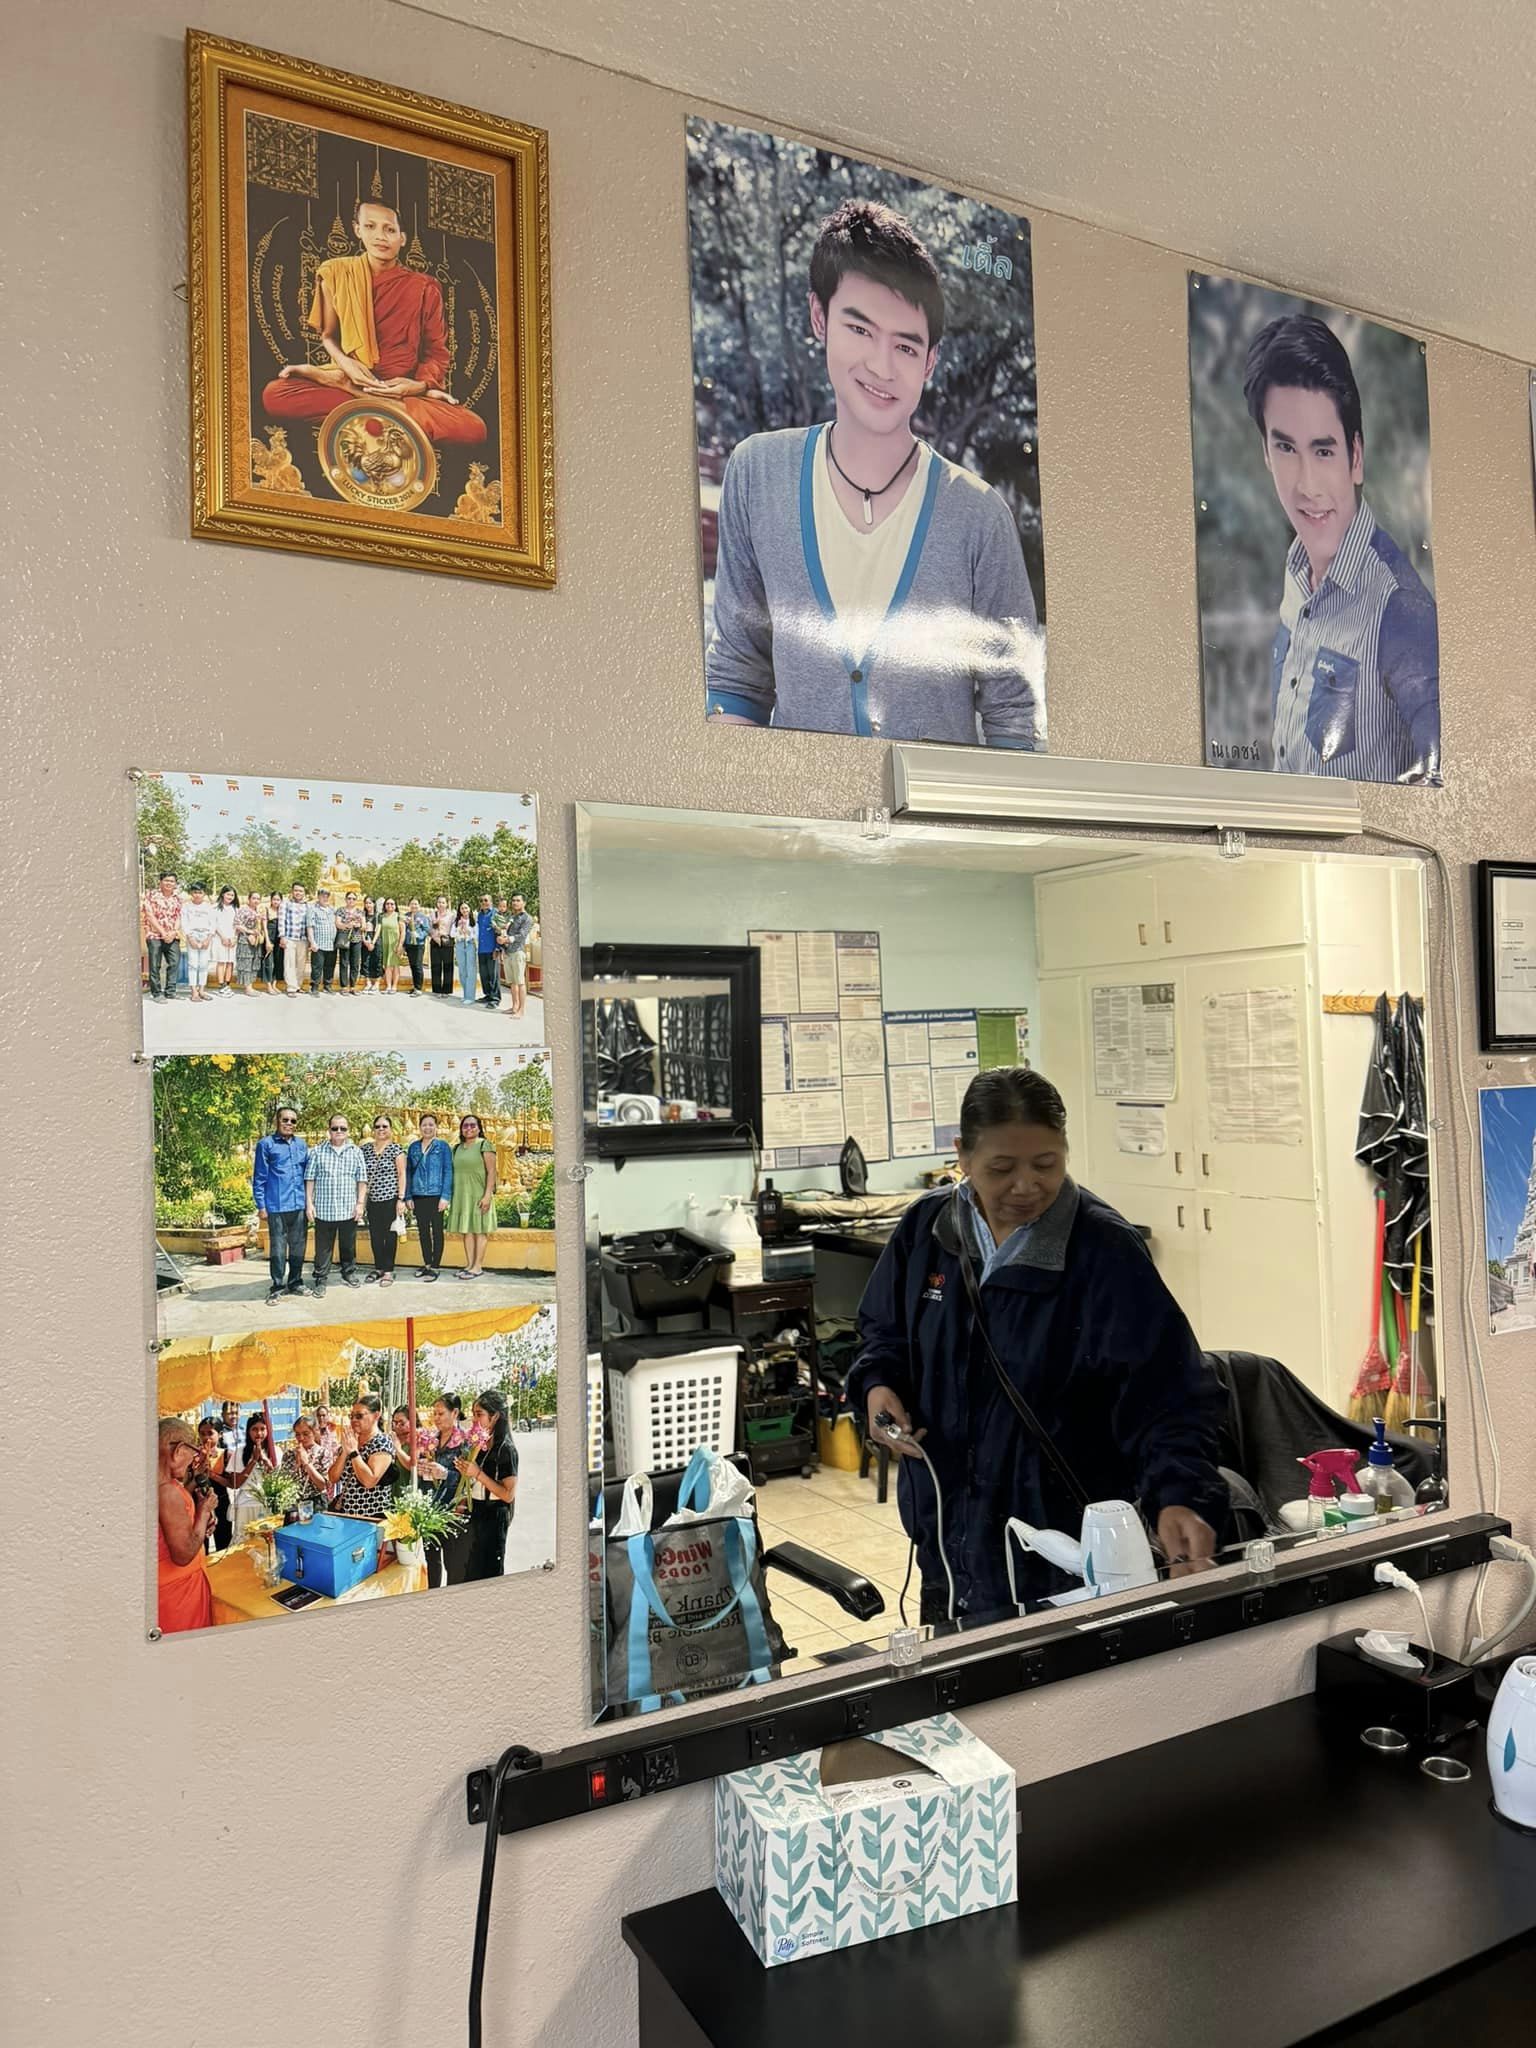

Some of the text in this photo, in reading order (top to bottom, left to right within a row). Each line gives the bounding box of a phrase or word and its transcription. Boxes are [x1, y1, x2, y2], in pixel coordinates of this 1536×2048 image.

[342, 479, 366, 499] LUCKY
[367, 495, 399, 505] STICKER
[801, 1930, 824, 1940] Simple
[801, 1936, 829, 1947] Softness
[777, 1937, 795, 1953] Puffs
